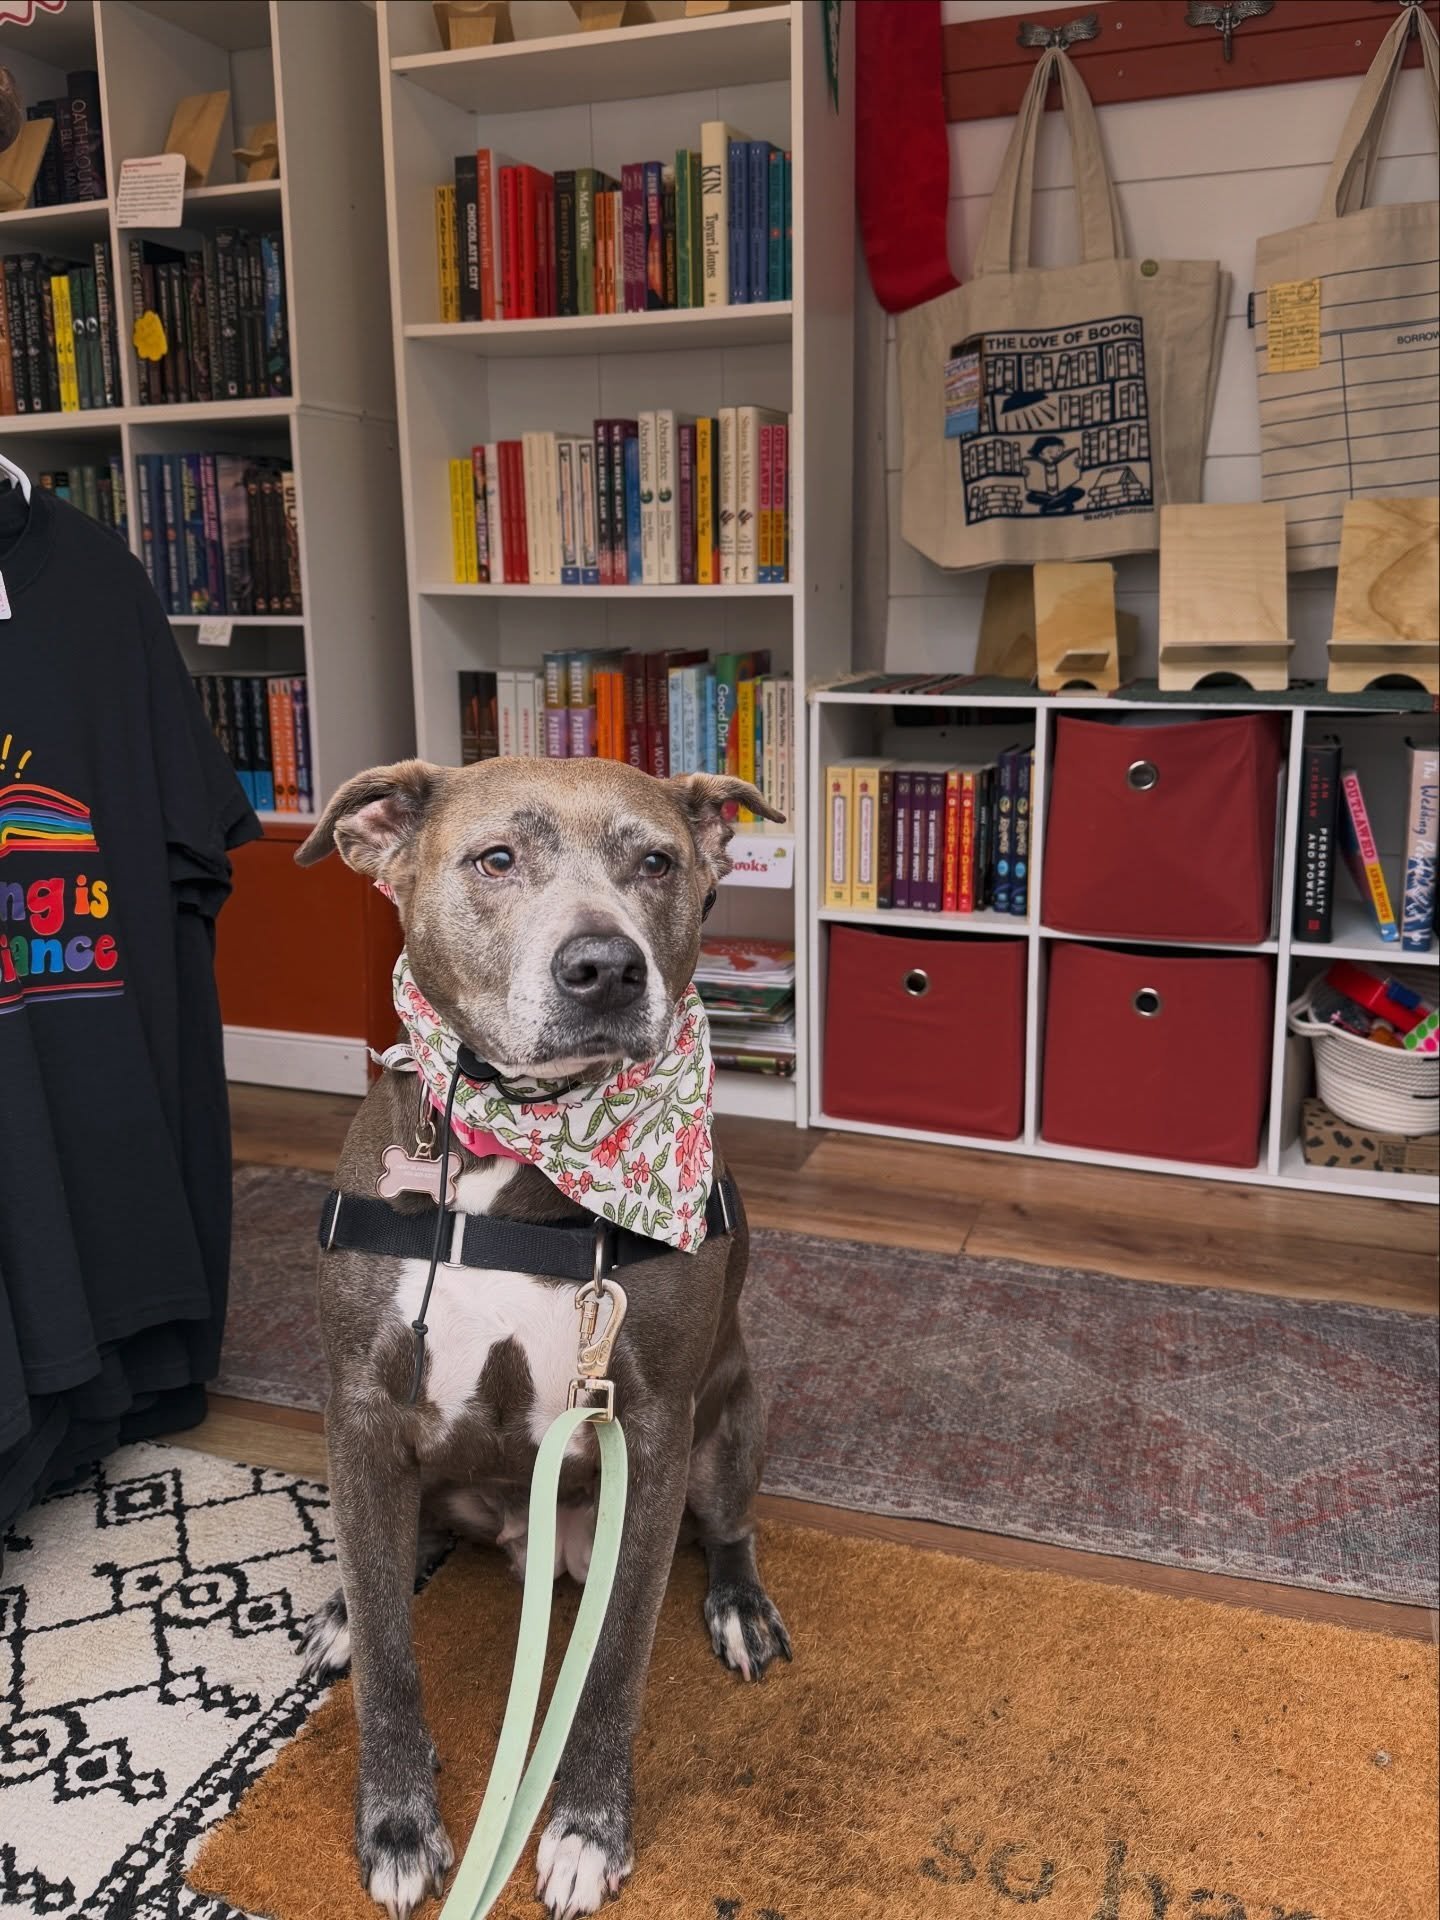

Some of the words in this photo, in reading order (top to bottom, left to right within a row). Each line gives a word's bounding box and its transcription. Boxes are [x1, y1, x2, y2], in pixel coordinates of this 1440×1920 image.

[702, 164, 721, 195] KIN
[579, 191, 589, 217] Mad
[467, 203, 478, 263] CHOCOLATE
[580, 220, 590, 249] Wife
[706, 213, 719, 246] Tayari
[469, 265, 480, 290] CITY
[706, 248, 719, 279] Jones
[986, 337, 1016, 350] THE
[1020, 335, 1058, 349] LOVE
[1063, 331, 1083, 344] OF
[1088, 322, 1140, 341] BOOKS
[640, 418, 651, 482] Abundance
[659, 416, 670, 480] Abundance
[761, 427, 770, 505] OUTLAWED
[775, 427, 784, 505] OUTLAWED
[634, 678, 643, 722] KRISTIN
[659, 679, 668, 724] KRISTIN
[718, 684, 729, 720] Good
[549, 717, 561, 755] PATRICK
[573, 716, 584, 755] PATRICK
[718, 723, 728, 747] Dirt
[654, 746, 664, 778] WOM
[1344, 778, 1375, 859] OUTLAWED
[1412, 785, 1438, 835] Wedding
[735, 858, 768, 872] ooks
[1307, 833, 1316, 858] AND
[946, 854, 954, 893] DESK
[962, 855, 970, 894] DESK
[1306, 863, 1315, 906] POWER
[1317, 827, 1327, 914] PERSONALITY
[0, 877, 65, 936] ng
[74, 874, 109, 919] is
[919, 1822, 1054, 1902] so
